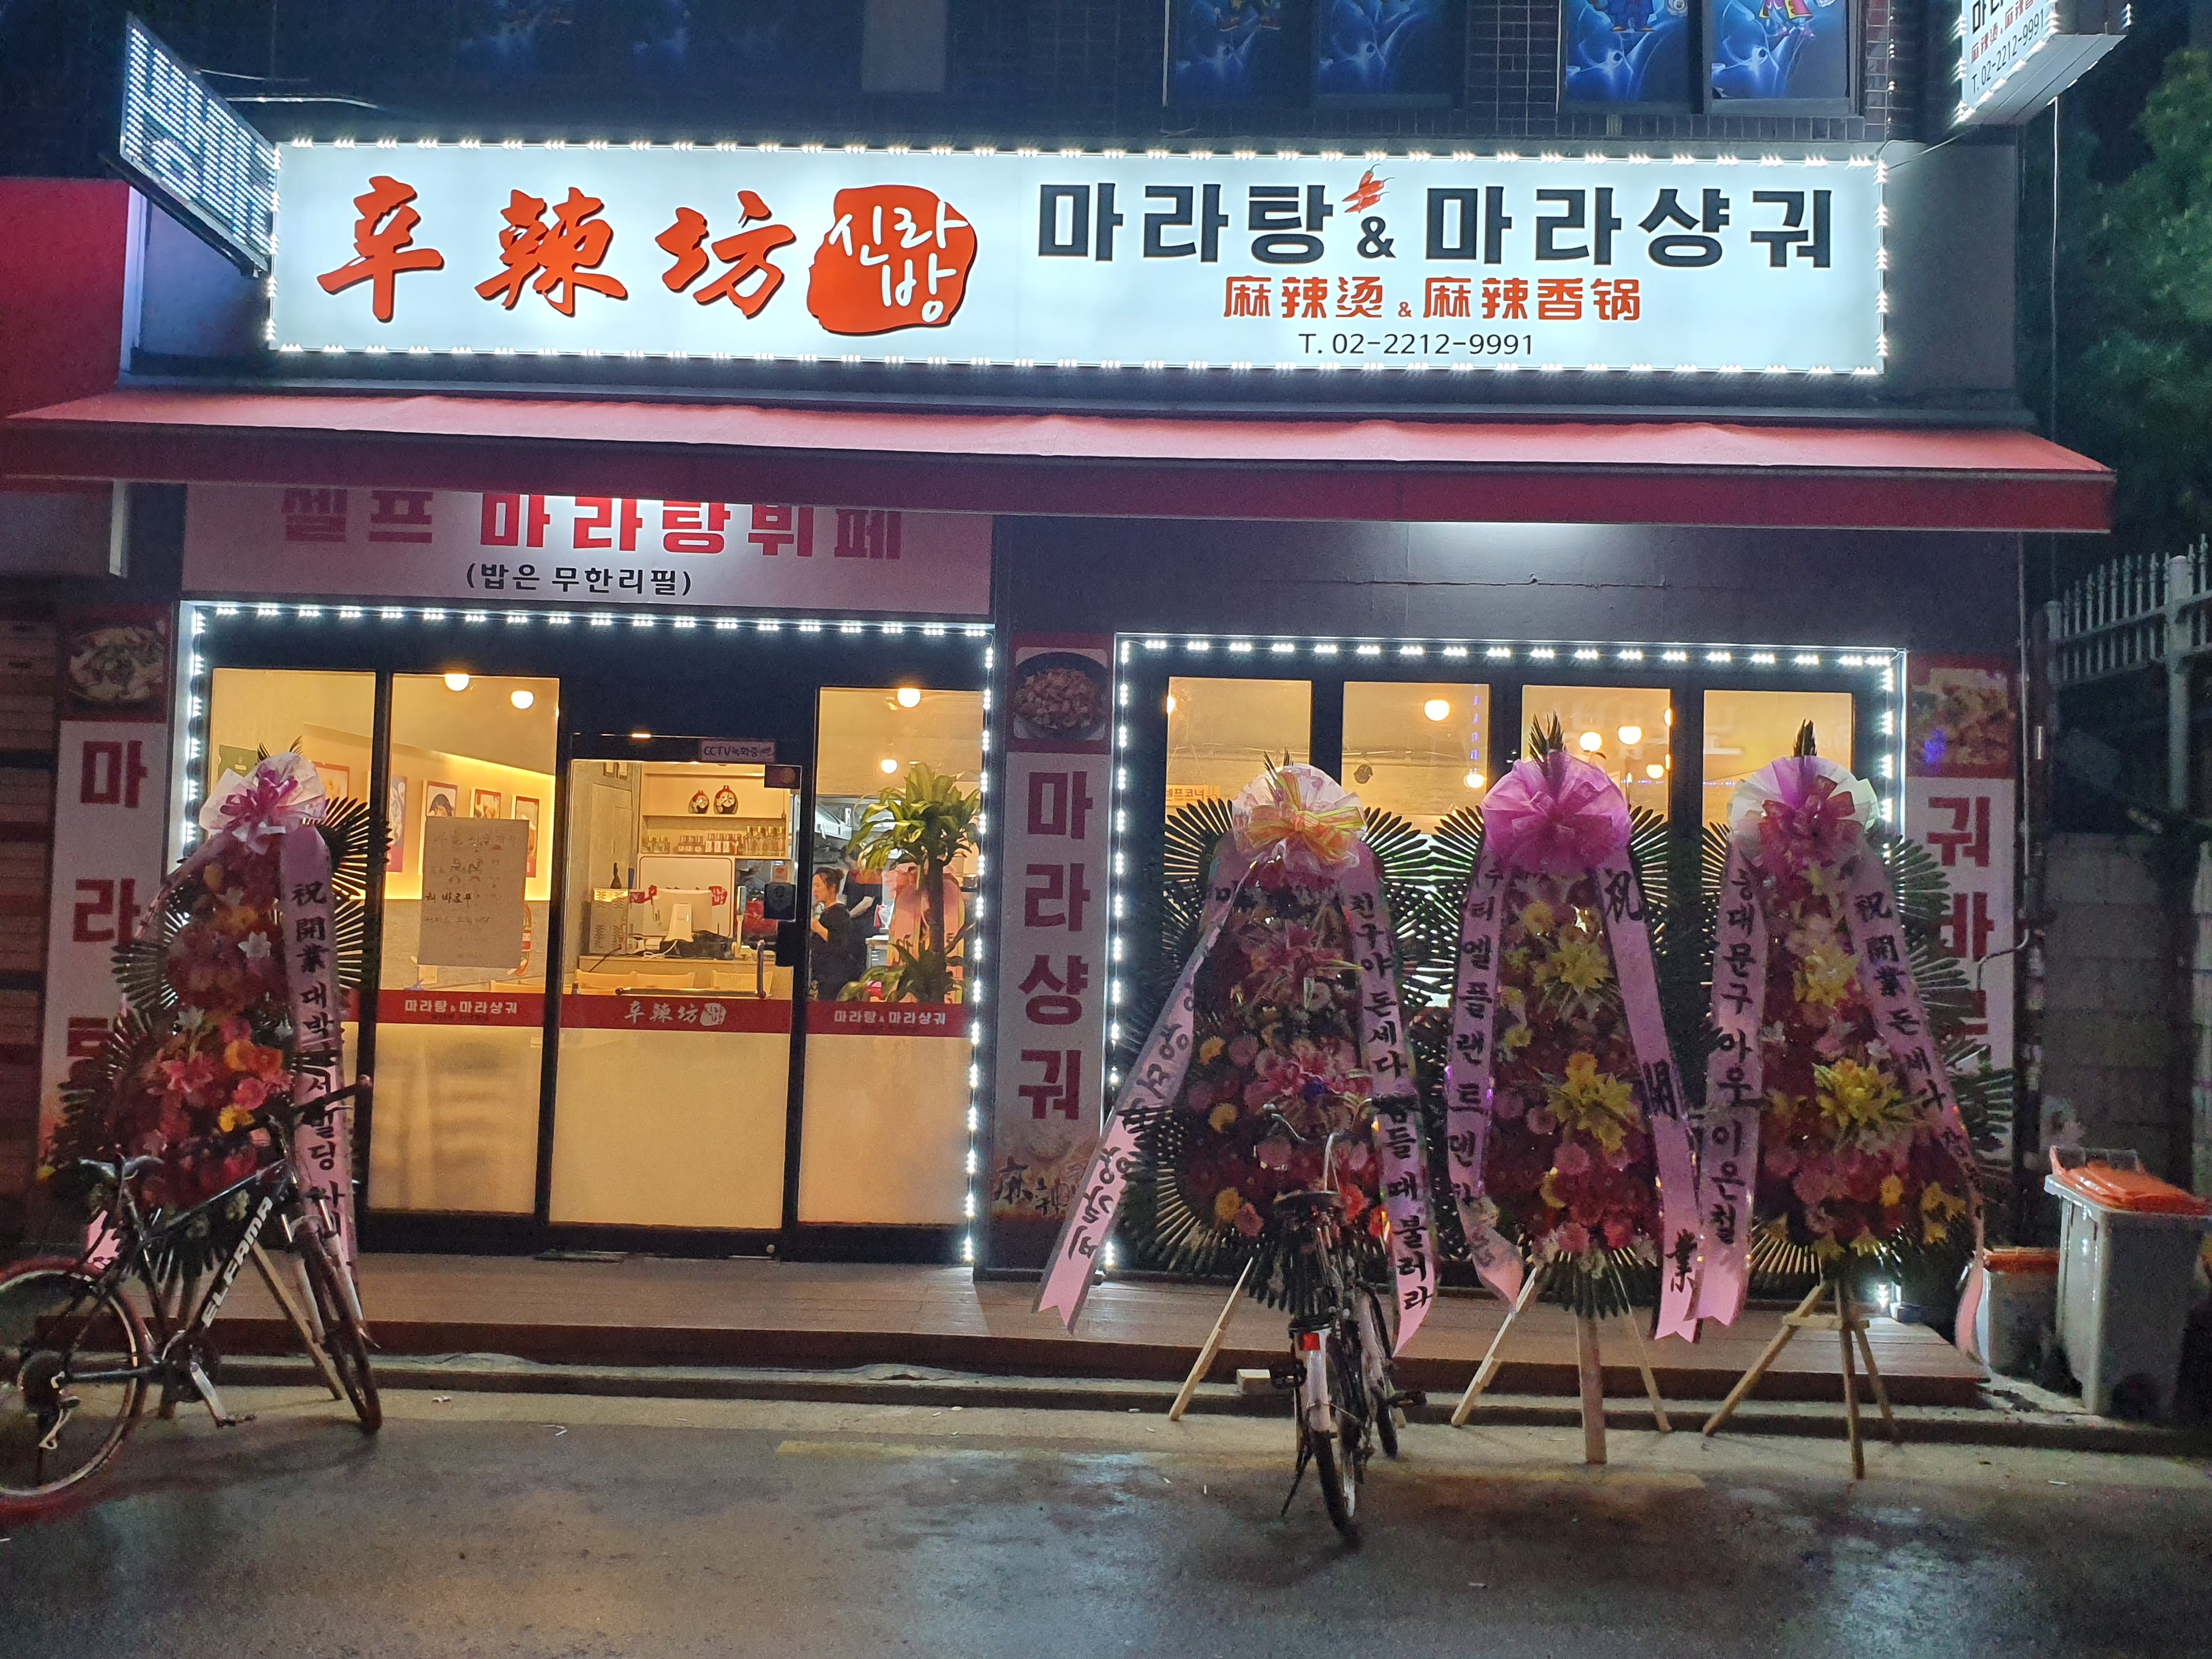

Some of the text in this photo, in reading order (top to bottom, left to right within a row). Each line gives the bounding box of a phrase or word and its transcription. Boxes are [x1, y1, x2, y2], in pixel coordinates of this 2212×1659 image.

[317, 176, 796, 321] 辛辣坊
[1038, 183, 1832, 269] 마라탕 & 마라샹궈
[1223, 275, 1641, 321] 麻辣烫 & 麻辣香锅
[466, 562, 692, 597] (밥은 무한리필)
[1018, 771, 1093, 1120] 마라샹궈
